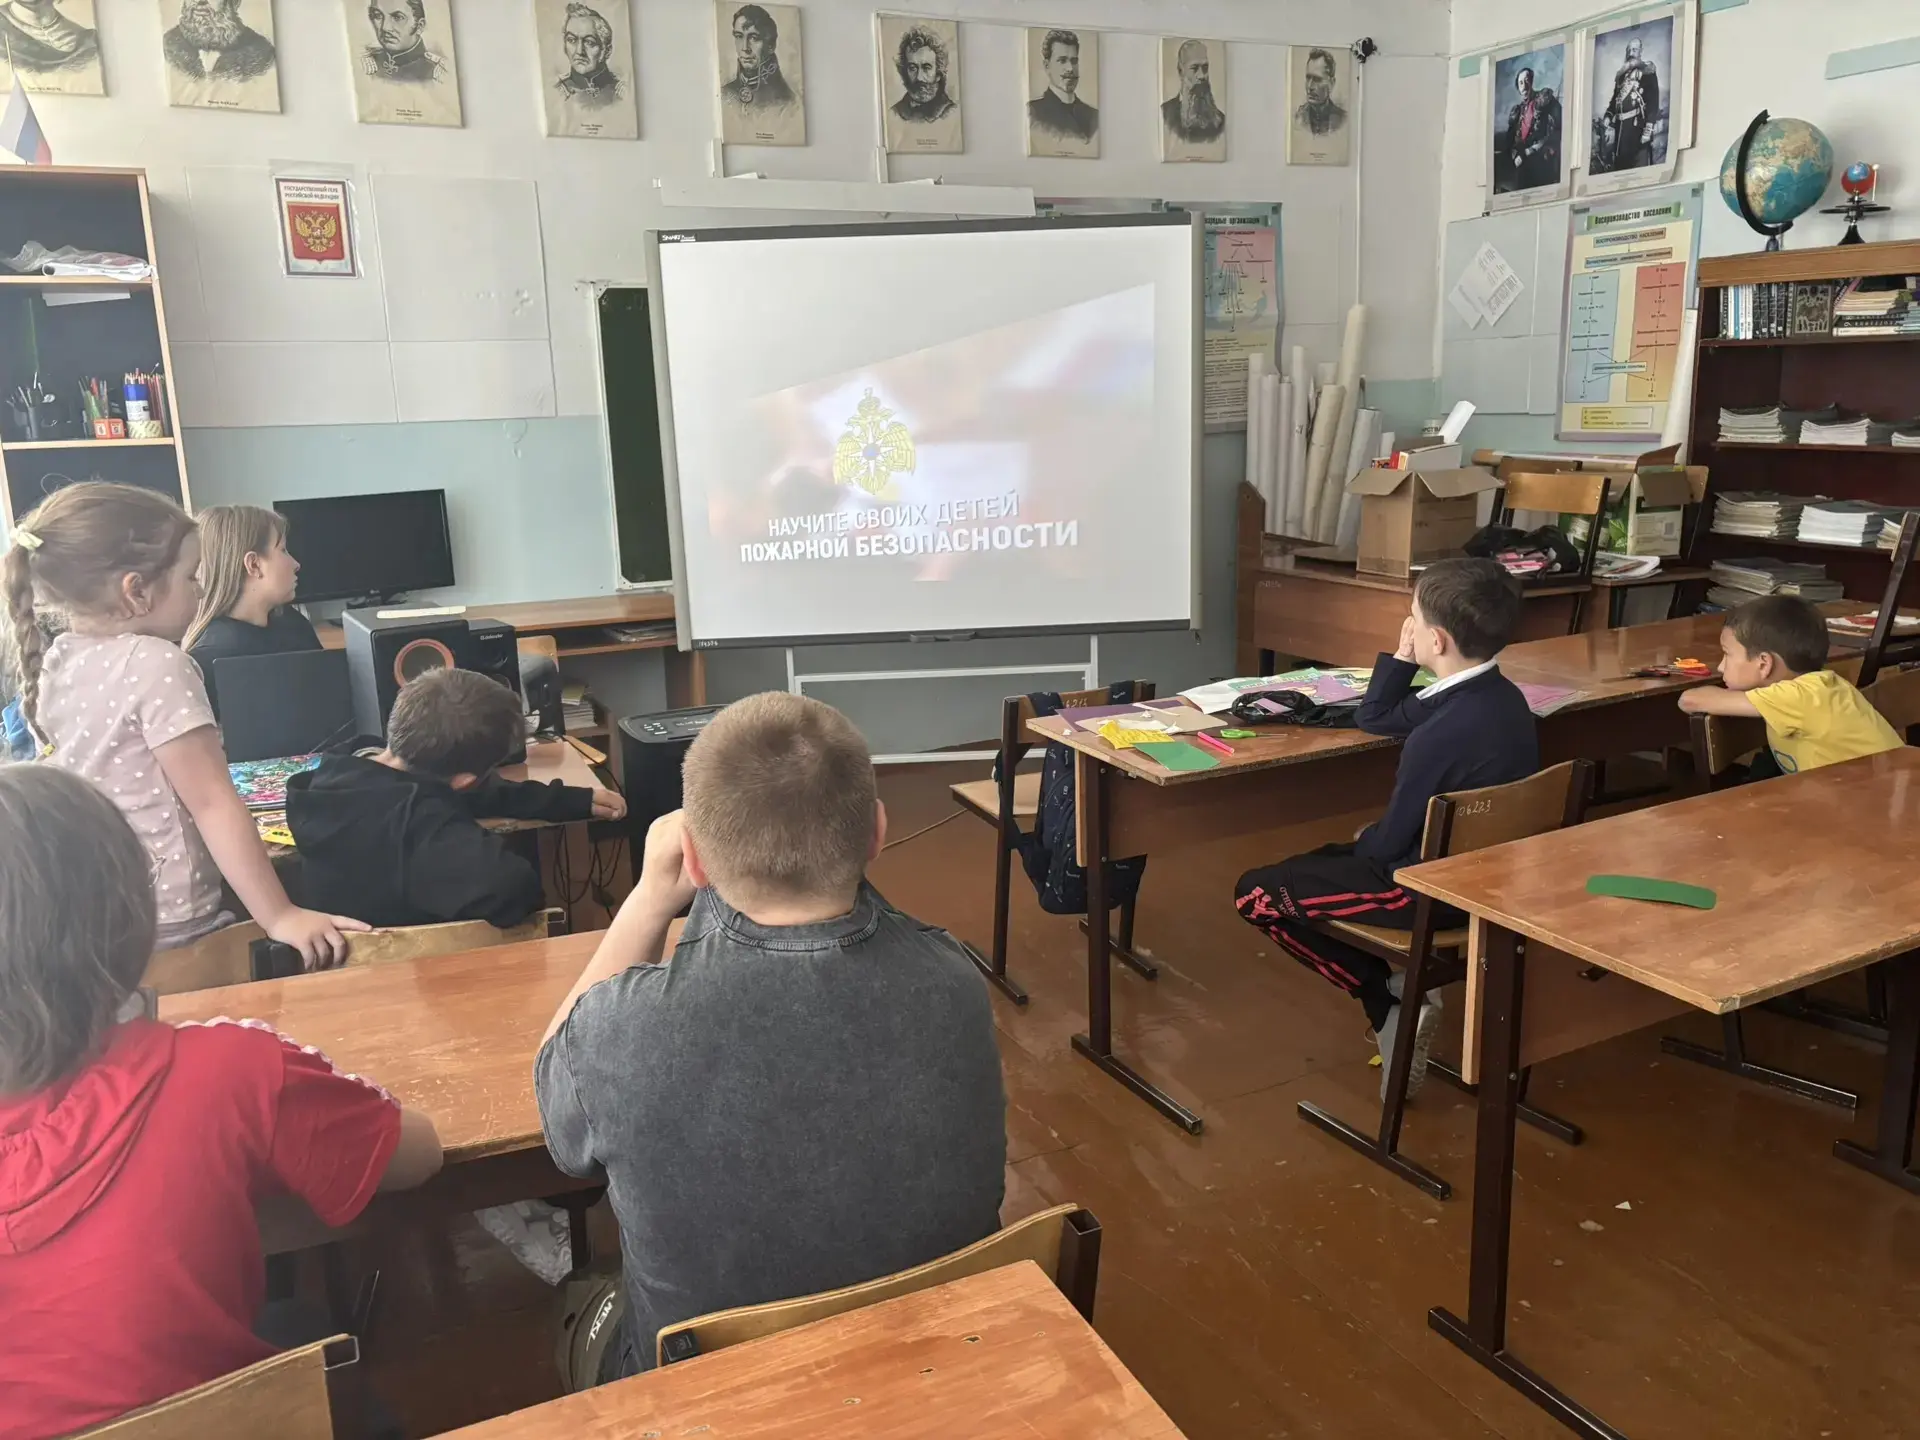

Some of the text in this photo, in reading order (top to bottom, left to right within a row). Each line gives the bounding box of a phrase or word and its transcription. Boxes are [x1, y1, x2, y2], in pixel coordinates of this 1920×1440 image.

[1594, 206, 1672, 225] Воспроизводство населения
[769, 489, 1019, 537] НАУЧИТЕ СВОИХ ДЕТЕЙ
[741, 519, 1079, 562] ПОЖАРНОЙ БЕЗОПАСНОСТИ
[1279, 886, 1300, 919] OTHERC
